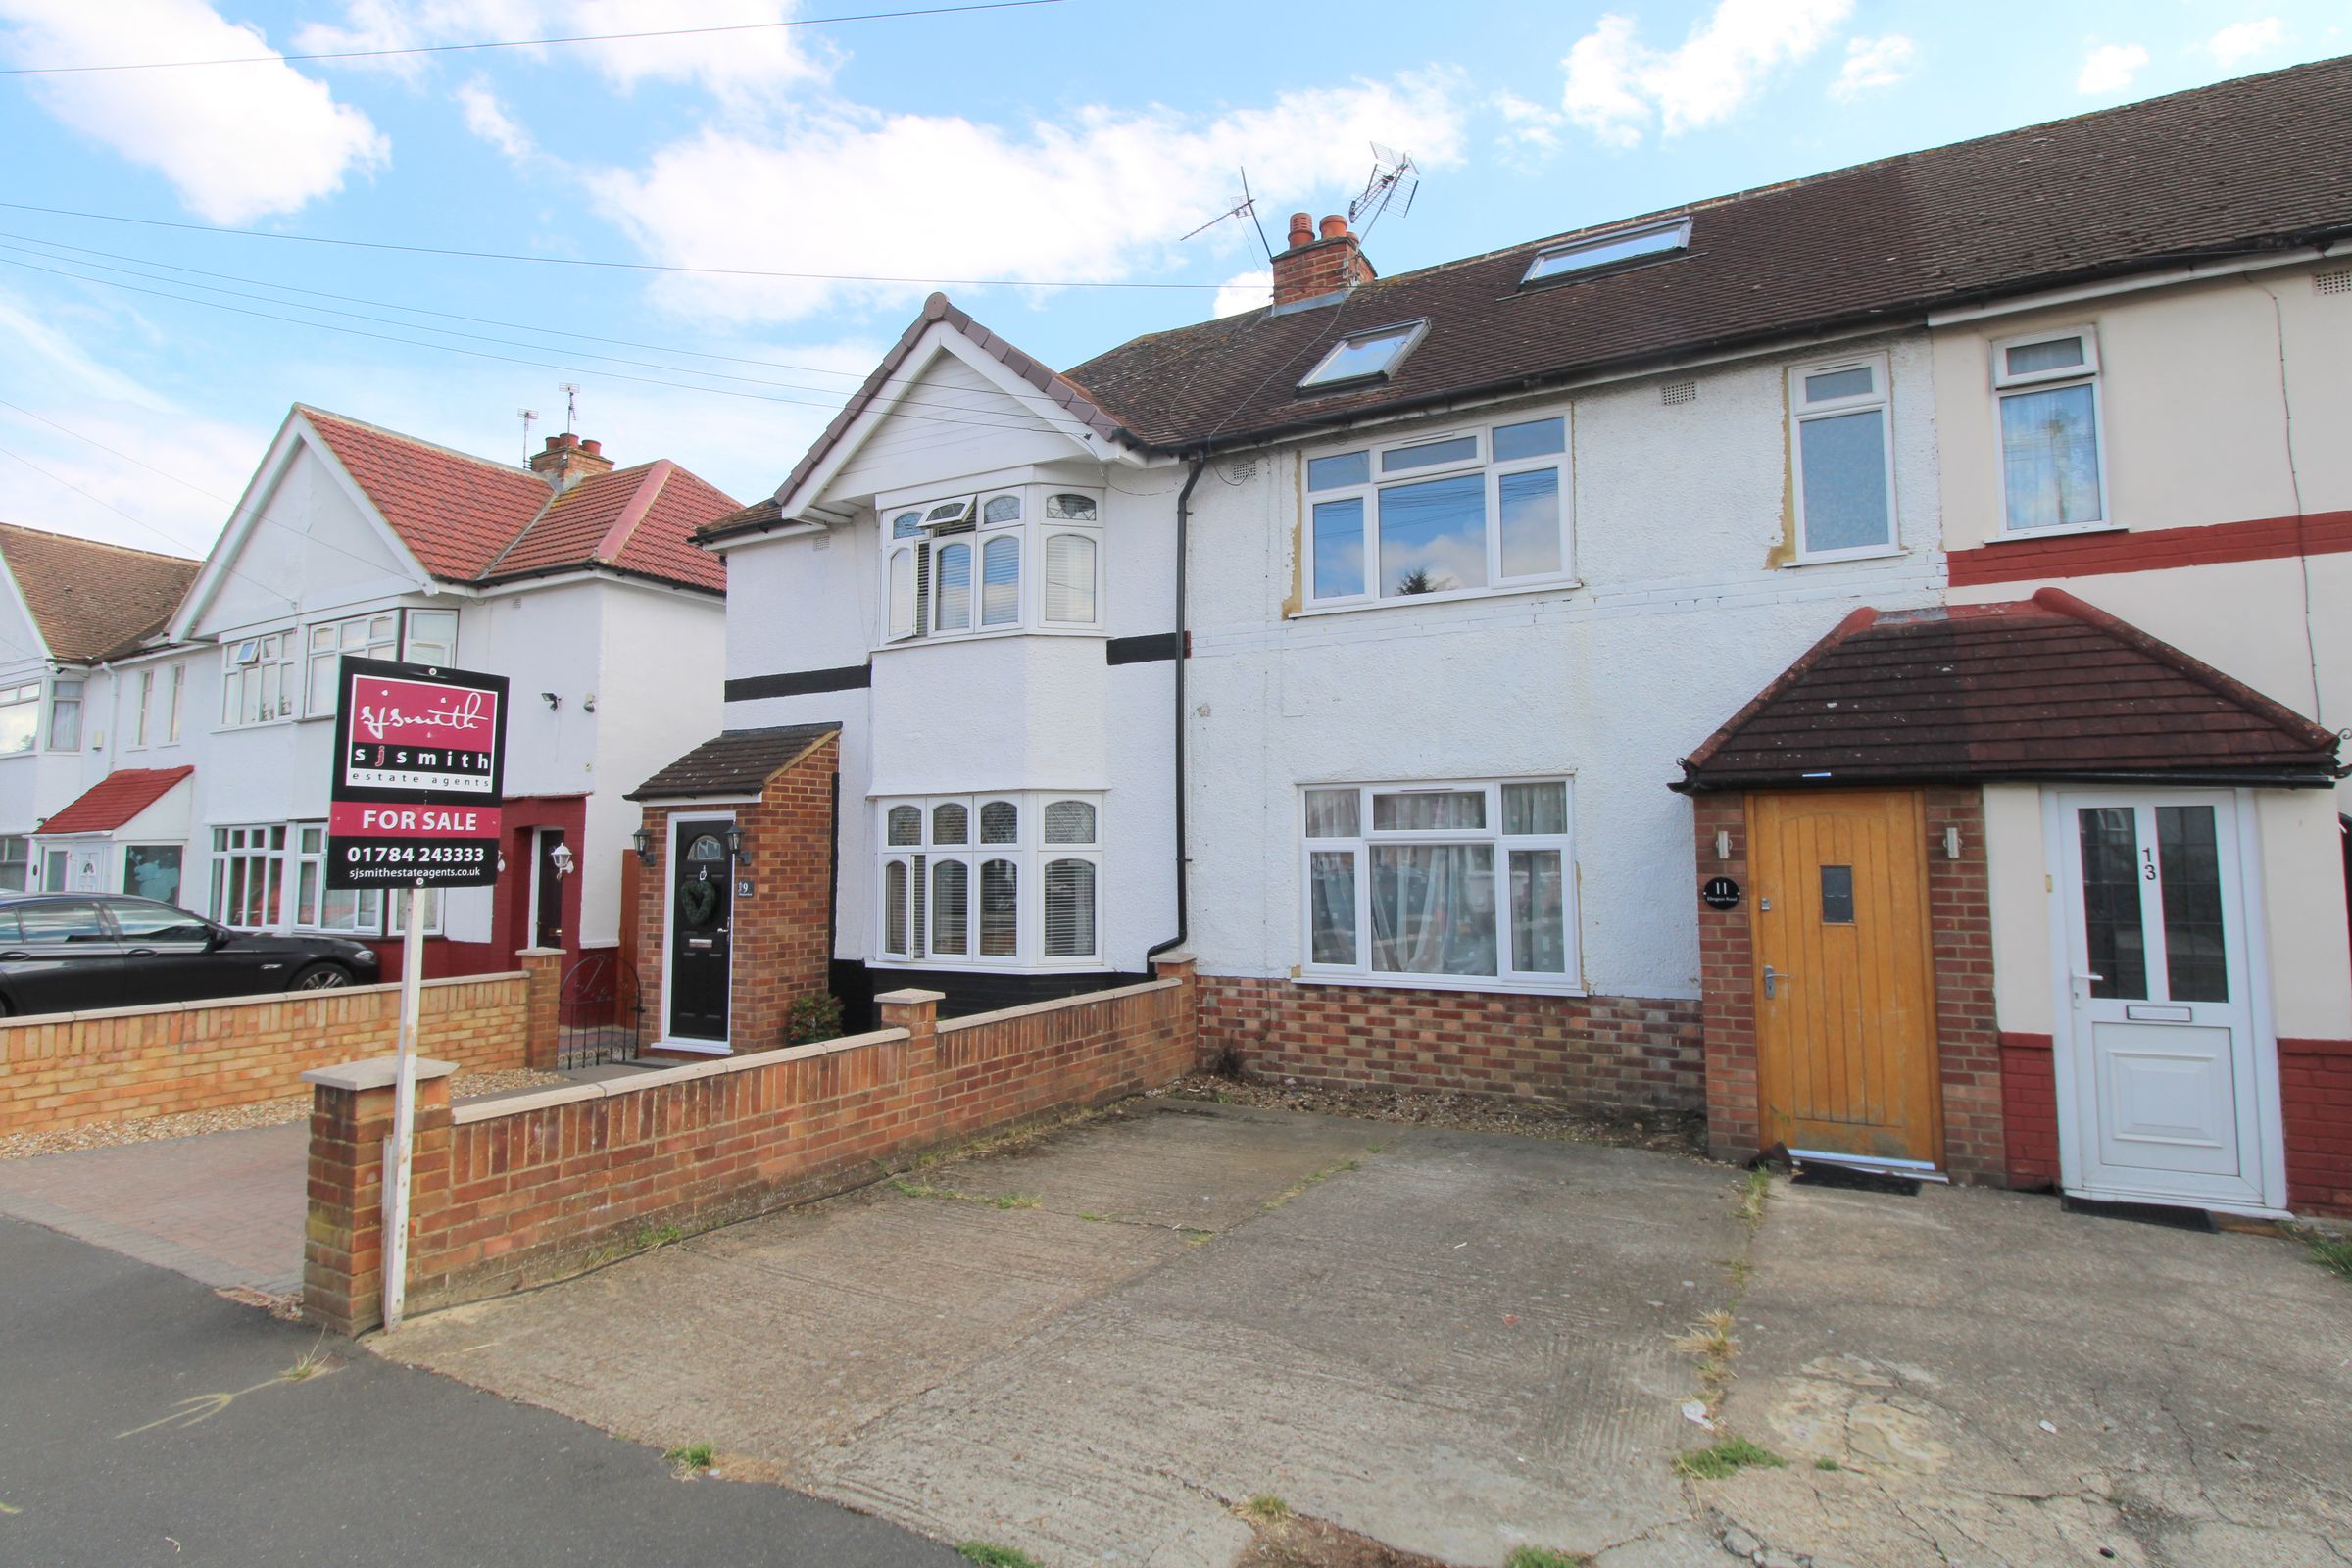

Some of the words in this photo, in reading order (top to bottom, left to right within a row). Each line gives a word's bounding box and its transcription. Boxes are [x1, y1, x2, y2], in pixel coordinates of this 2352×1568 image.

[352, 772, 419, 783] estate
[431, 776, 489, 787] agents
[363, 809, 416, 830] FOR
[422, 811, 477, 831] SALE
[347, 846, 415, 862] 01784
[418, 847, 484, 862] 243333
[349, 866, 480, 880] sjsmithestateagents.co.uk
